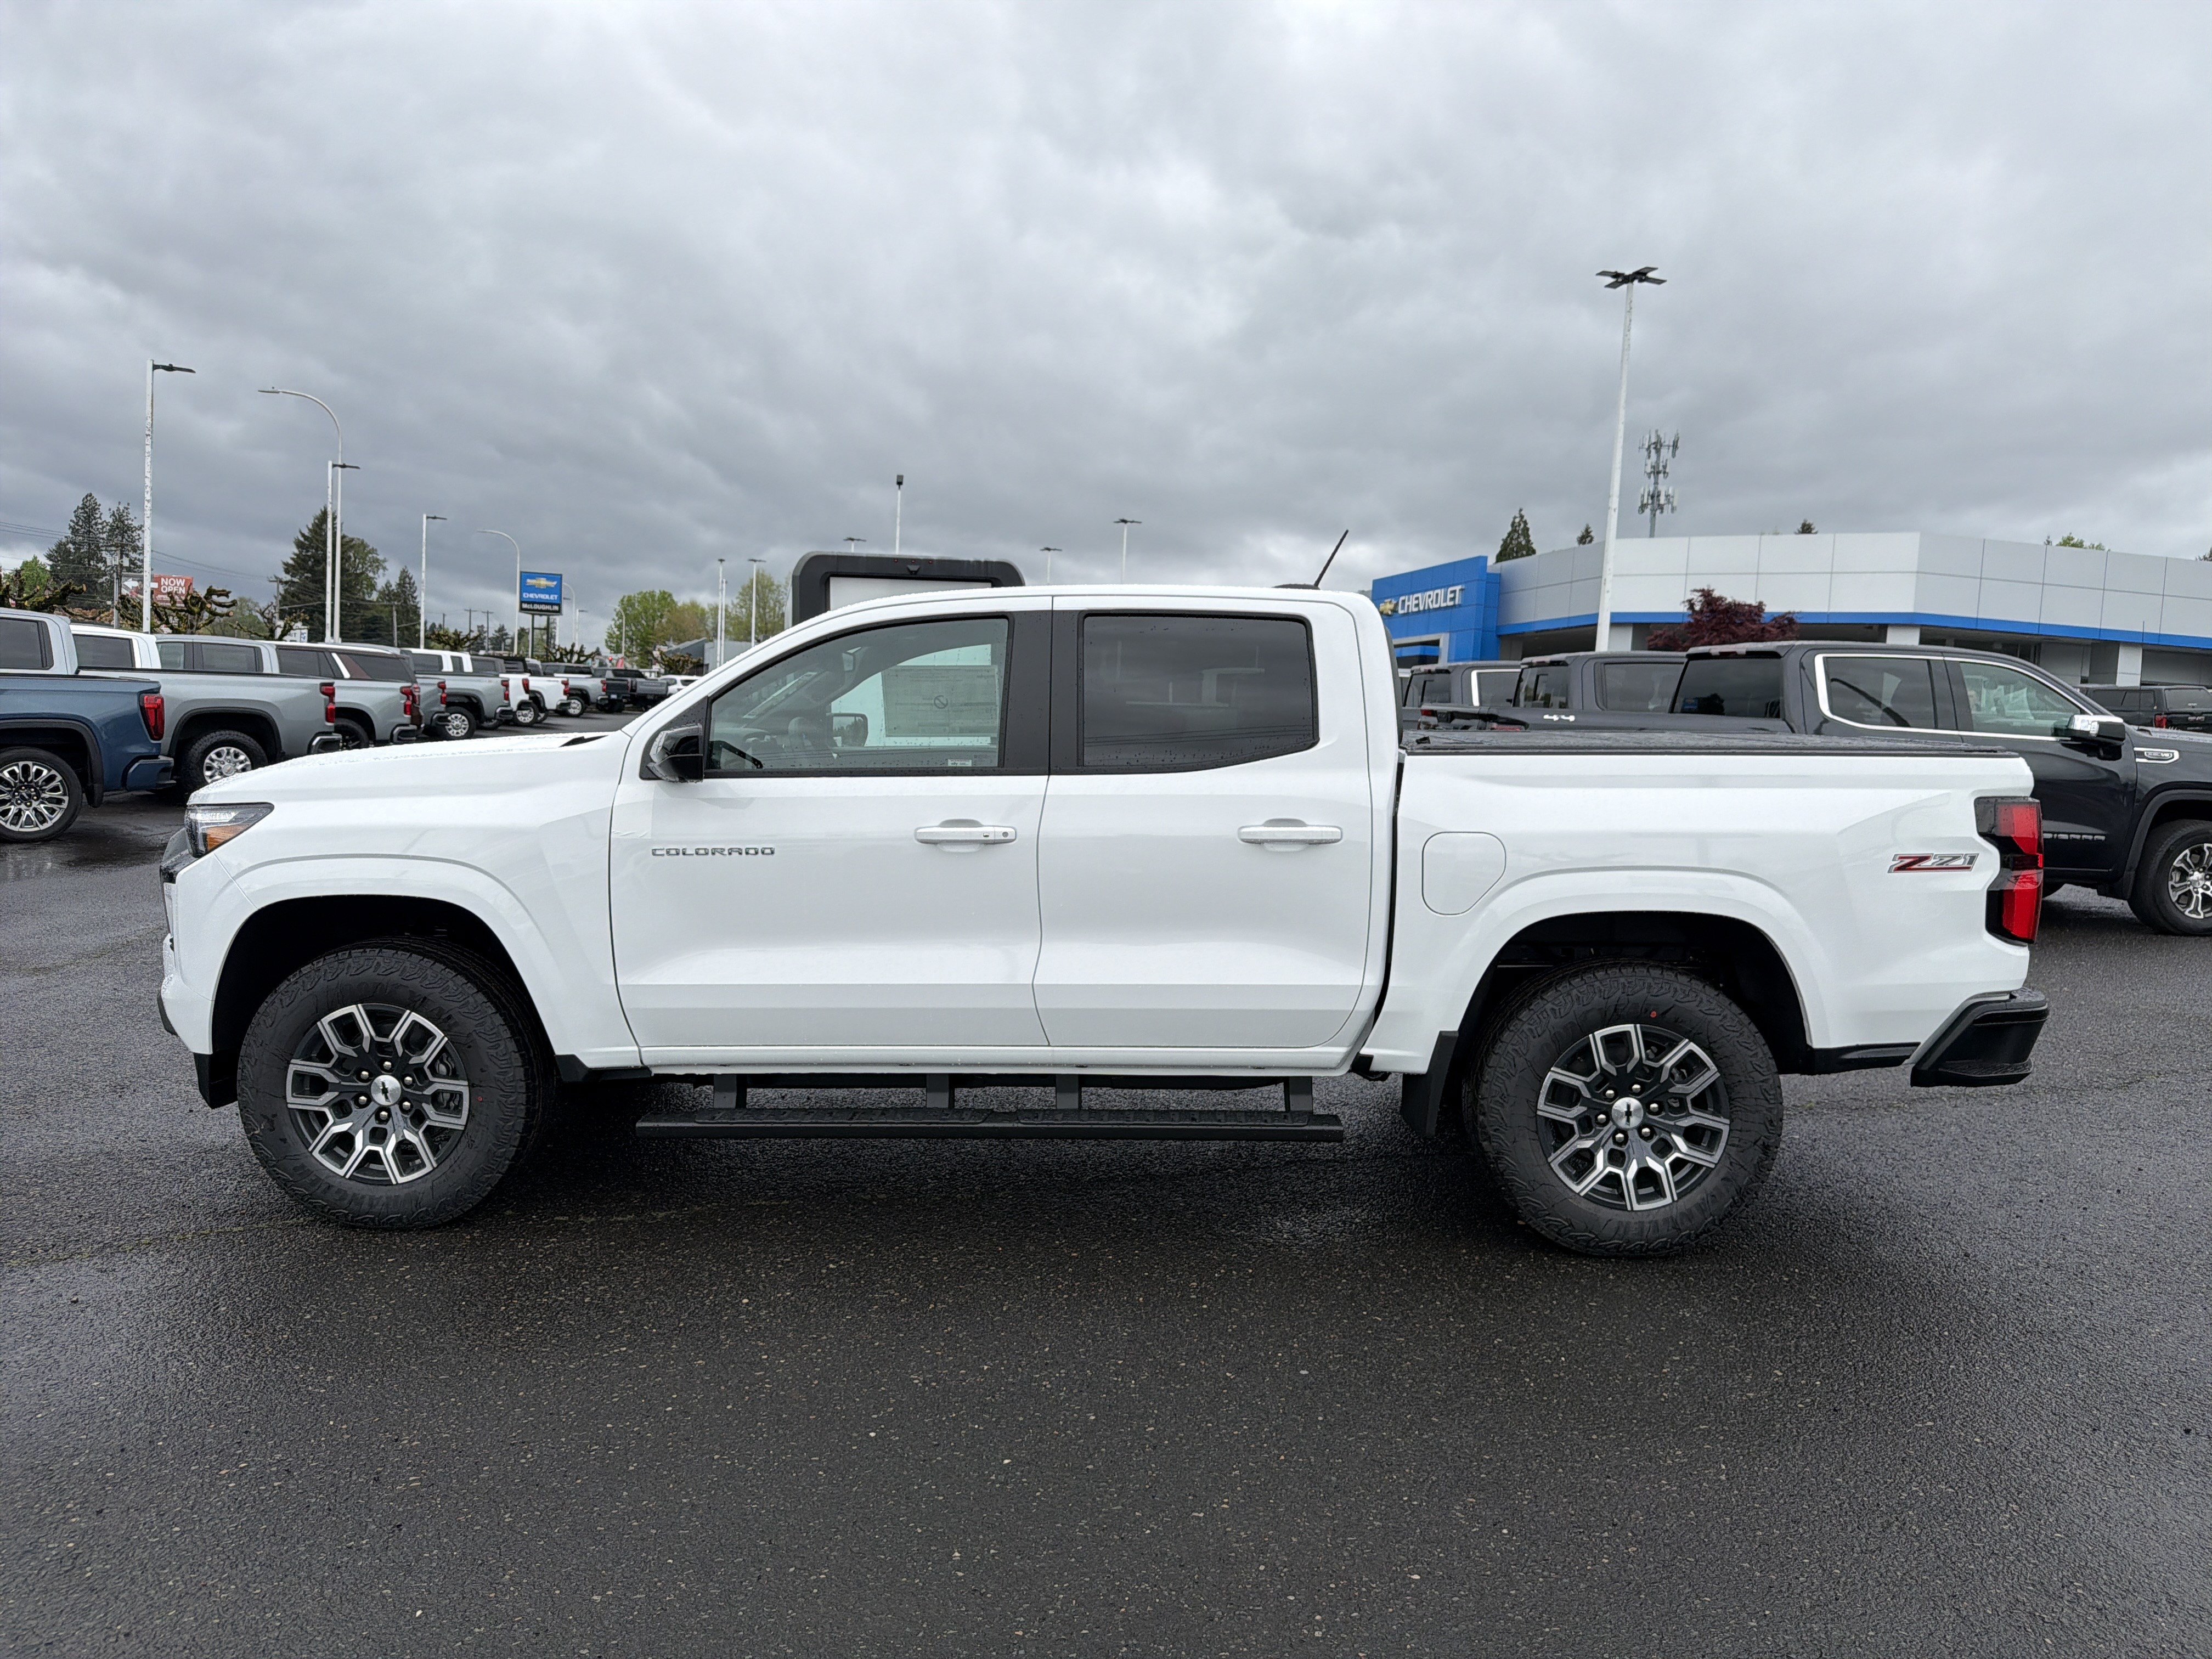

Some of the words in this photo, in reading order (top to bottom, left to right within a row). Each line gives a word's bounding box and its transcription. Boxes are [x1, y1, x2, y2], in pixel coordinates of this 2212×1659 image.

[161, 577, 185, 586] NOW
[161, 586, 185, 594] OPEN
[523, 592, 558, 601] CHEVROLET
[1398, 585, 1463, 614] CHEVROLET
[651, 847, 775, 856] COLORADO
[1888, 853, 1979, 873] Z71
